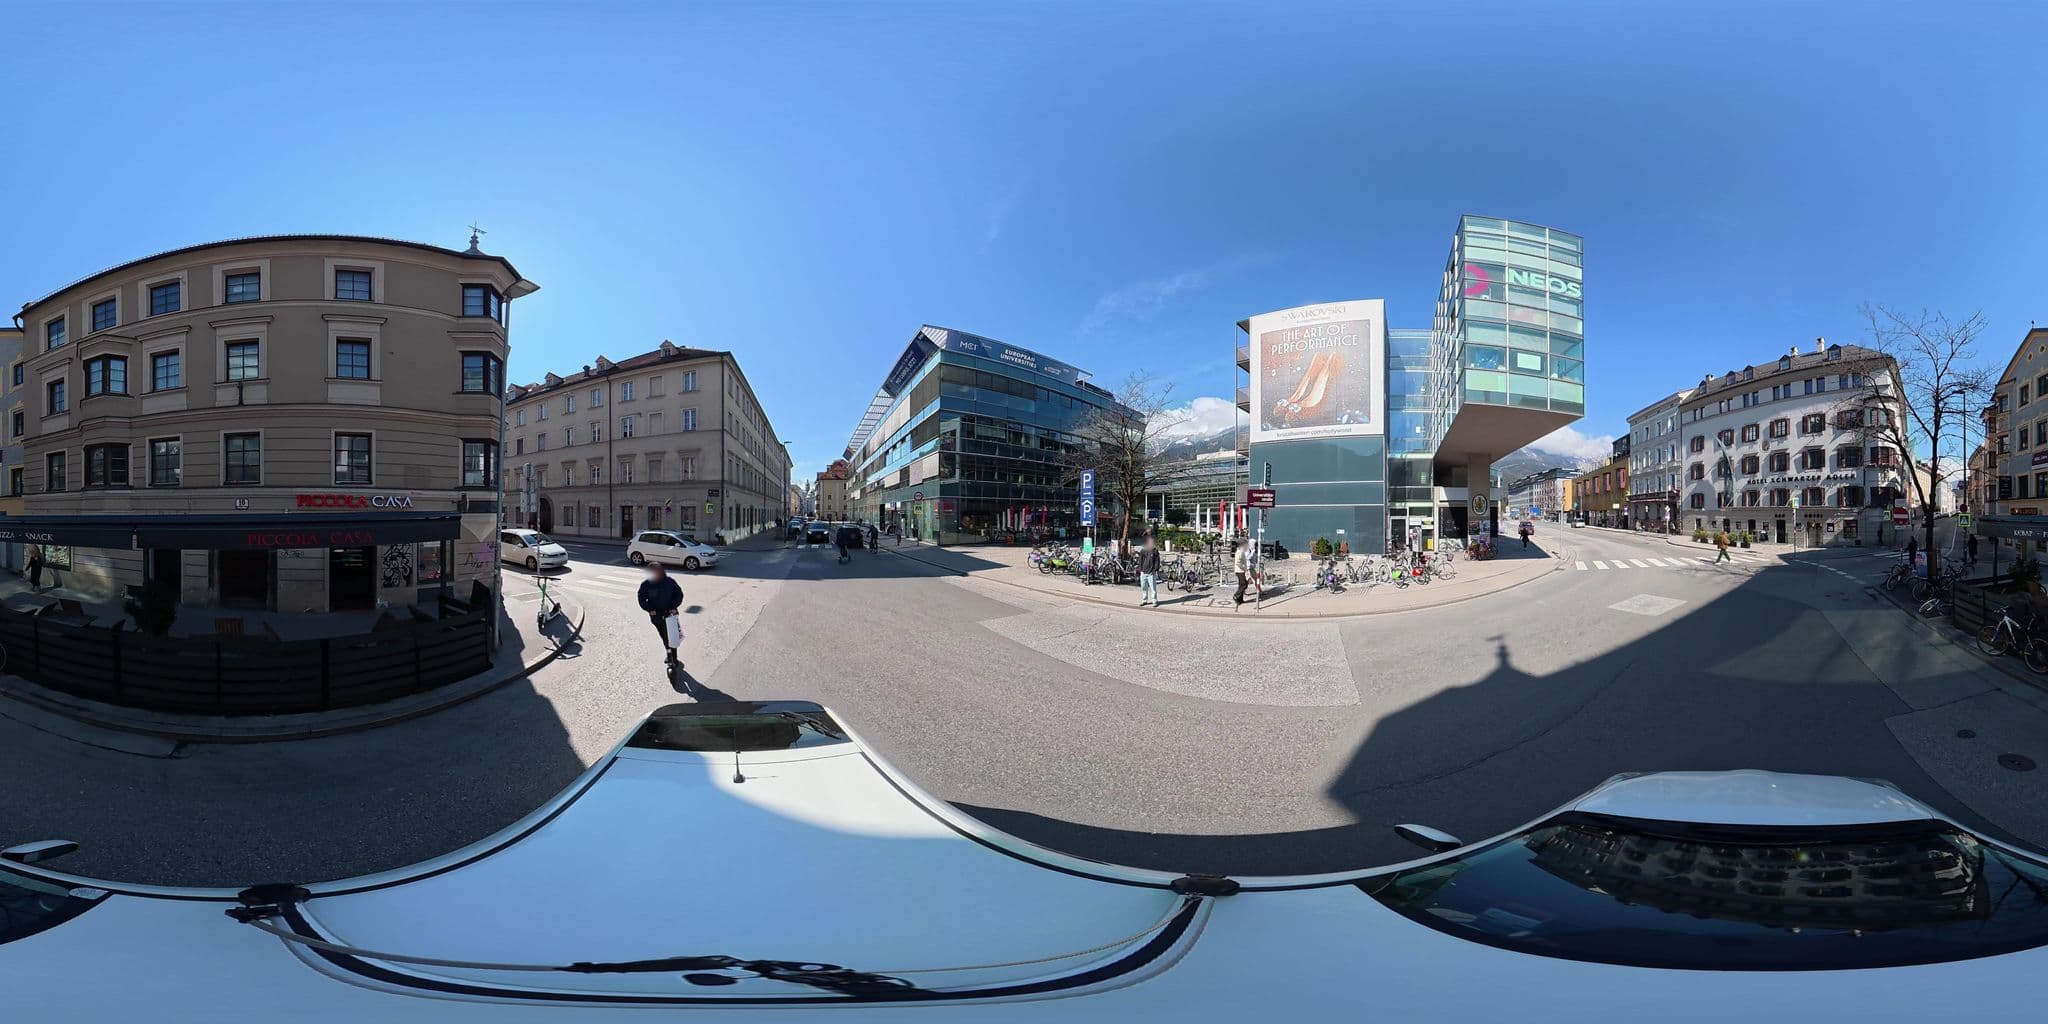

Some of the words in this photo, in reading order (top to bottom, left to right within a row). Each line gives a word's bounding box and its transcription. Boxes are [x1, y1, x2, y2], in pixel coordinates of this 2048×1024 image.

[1509, 269, 1582, 298] NEOS
[1281, 305, 1346, 321] SWAROVSKI
[1282, 329, 1299, 342] THE
[1304, 326, 1323, 340] ART
[1327, 323, 1347, 336] OF
[1271, 334, 1358, 356] PERFORMANCE
[1000, 353, 1037, 369] UNIVERSITIES
[1005, 348, 1036, 362] EUROPEAN
[1083, 473, 1092, 489] P
[1771, 475, 1822, 483] SCHWARZER
[296, 494, 369, 508] PICCOLA
[372, 495, 413, 509] CASA
[24, 532, 54, 541] SNACK
[248, 532, 319, 547] PICCOLA
[330, 532, 374, 546] CASA
